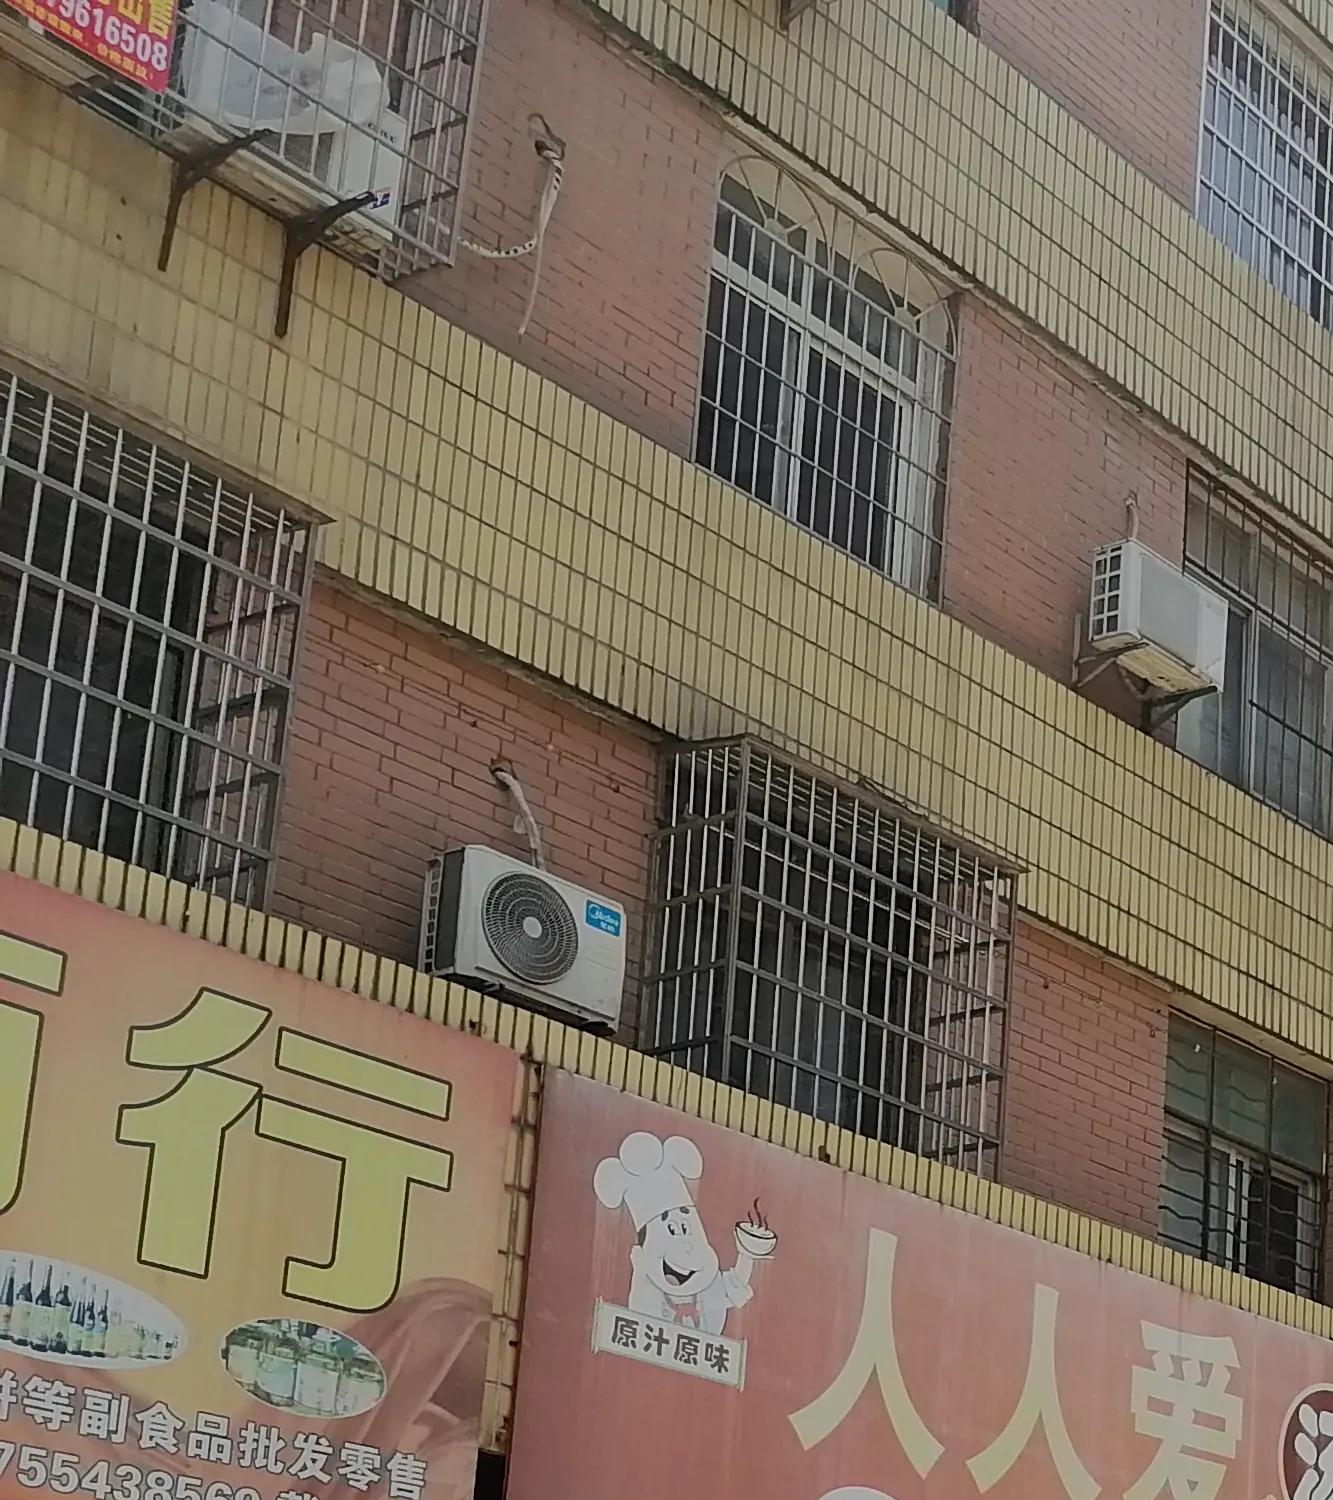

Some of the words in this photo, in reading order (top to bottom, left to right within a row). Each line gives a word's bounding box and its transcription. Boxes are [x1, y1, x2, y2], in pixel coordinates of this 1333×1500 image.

[46, 0, 168, 71] 9616508
[611, 1315, 731, 1375] 原汁原味
